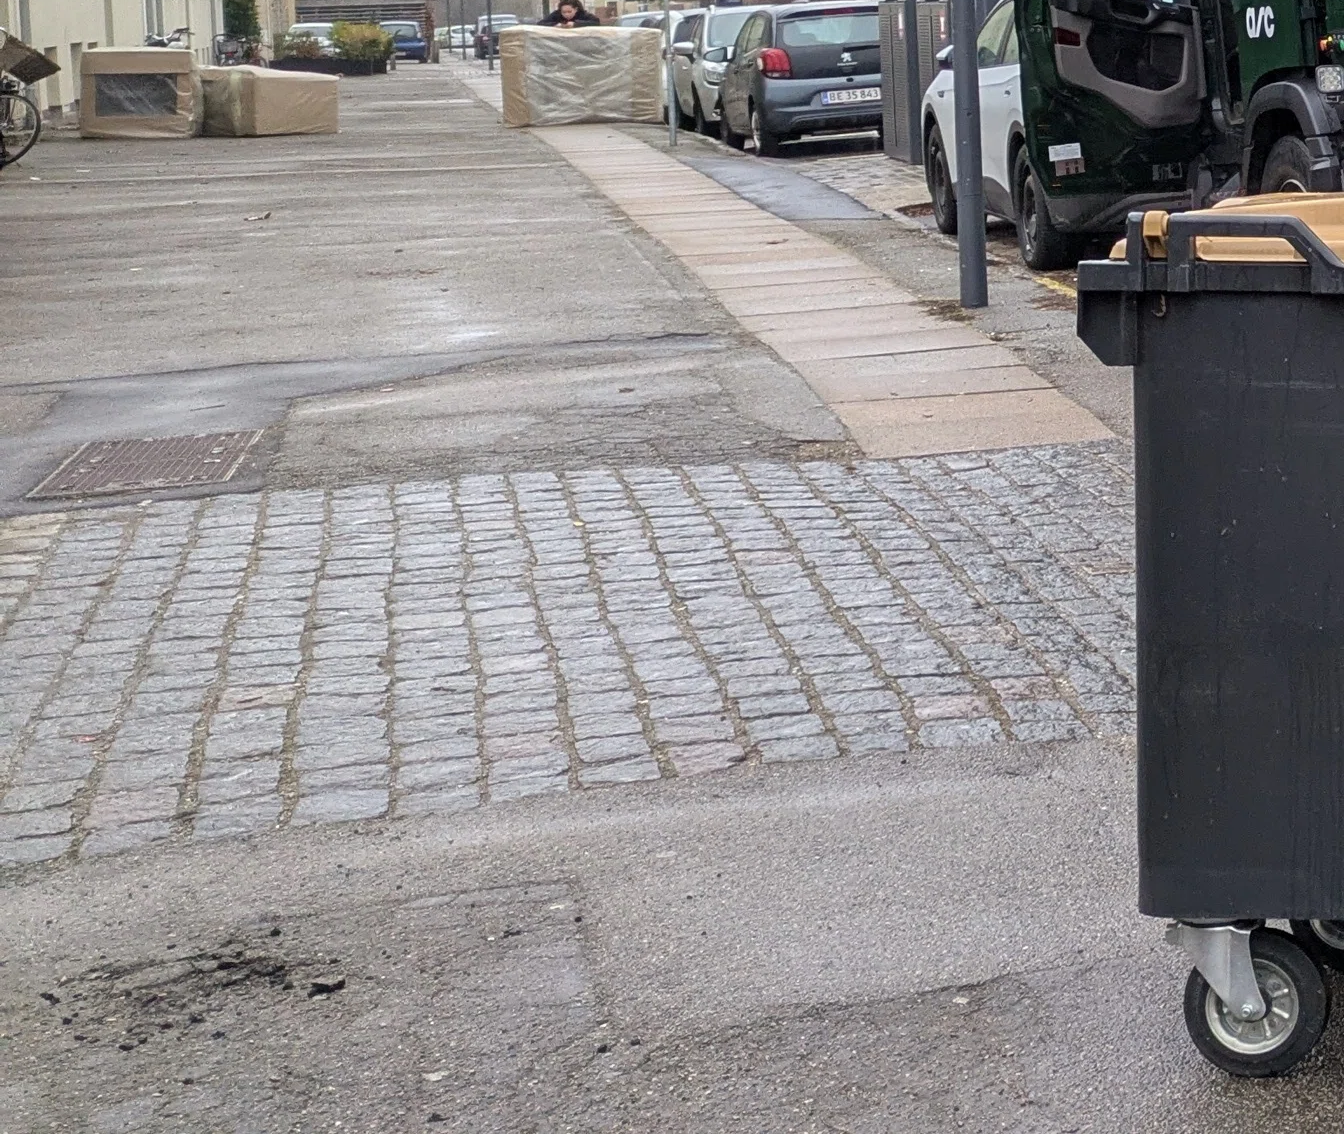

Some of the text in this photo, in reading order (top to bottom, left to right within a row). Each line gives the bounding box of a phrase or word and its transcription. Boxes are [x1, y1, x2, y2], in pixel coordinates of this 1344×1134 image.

[829, 89, 879, 101] BE 35 843
